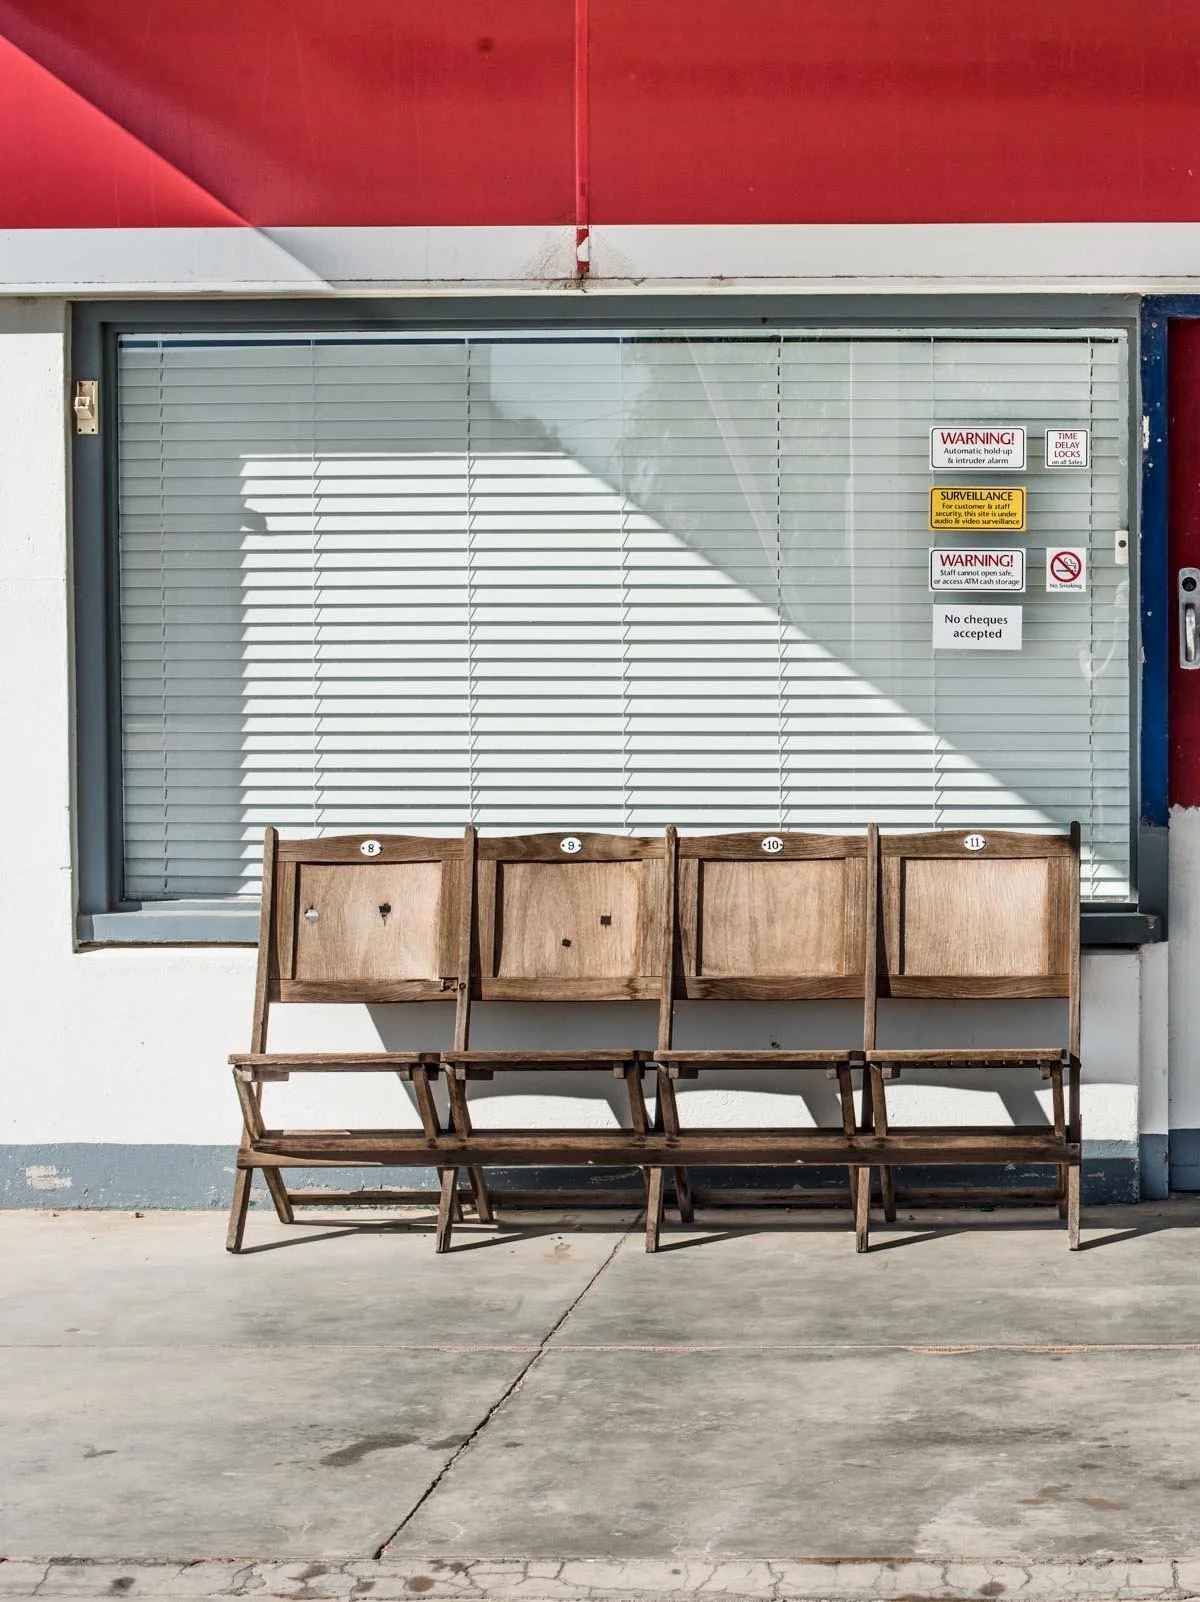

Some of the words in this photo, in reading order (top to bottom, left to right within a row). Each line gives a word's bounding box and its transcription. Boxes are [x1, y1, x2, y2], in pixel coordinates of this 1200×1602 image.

[941, 432, 1015, 445] WARNING!
[984, 448, 1012, 456] hold-up
[941, 492, 1013, 500] SURVEILLANCE
[940, 554, 1013, 567] WARNING!
[945, 615, 960, 623] No
[964, 615, 1008, 626] cheques
[954, 629, 1002, 640] accepted
[568, 841, 574, 850] 9
[768, 841, 778, 849] 10
[971, 838, 979, 847] 11
[368, 844, 374, 852] 8
